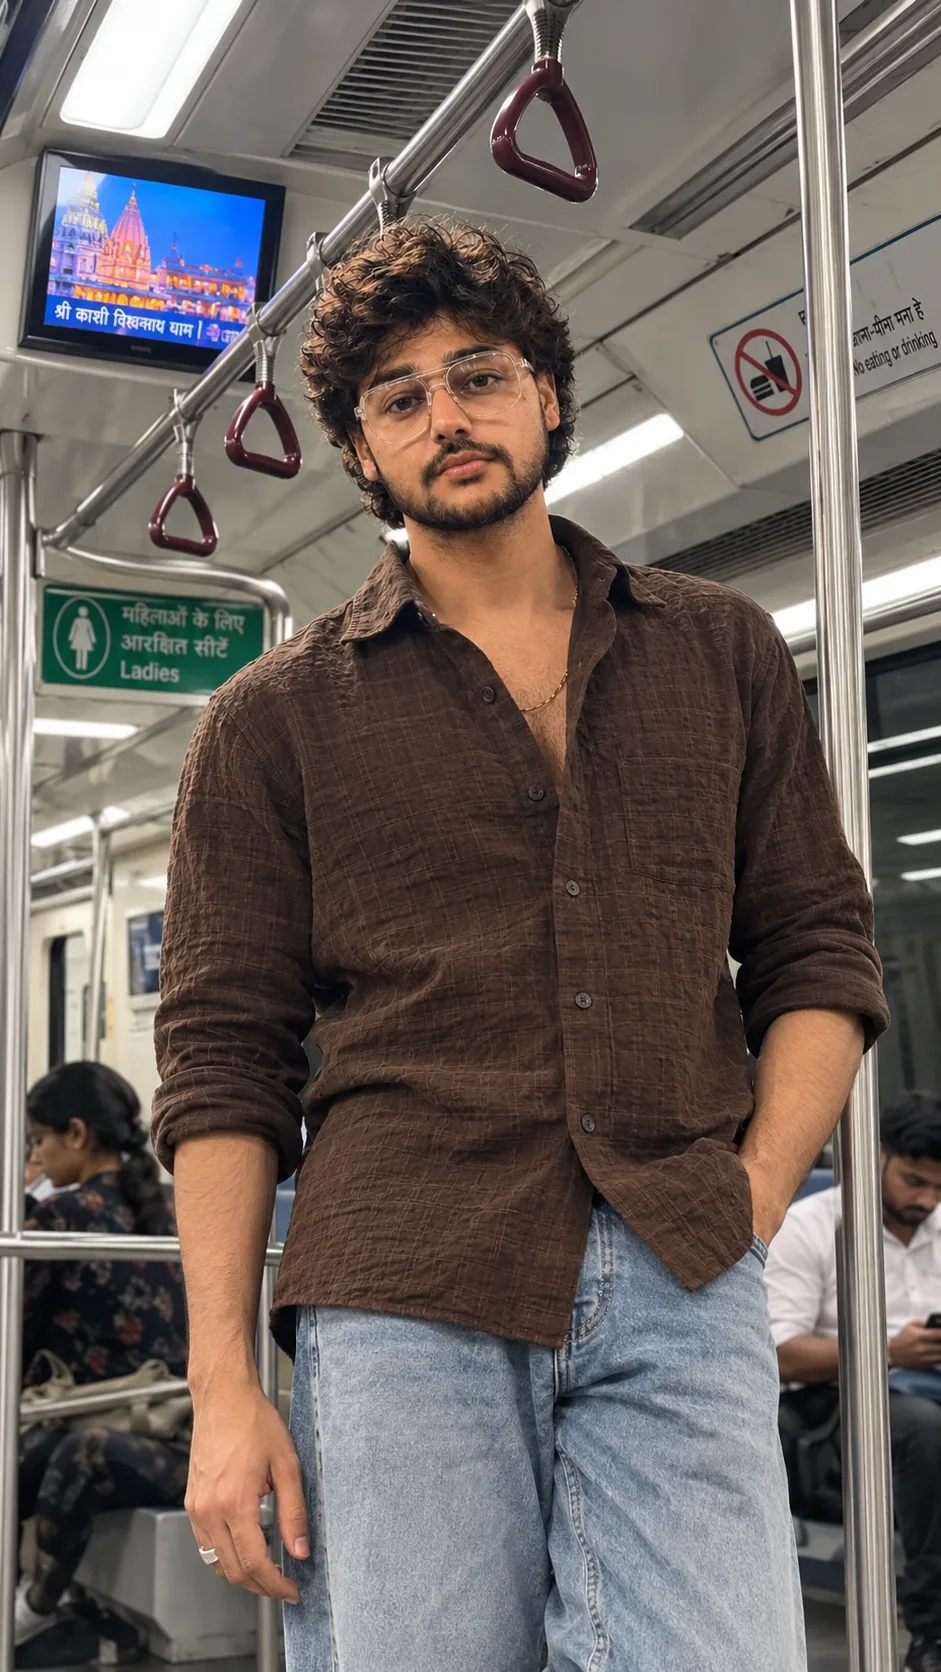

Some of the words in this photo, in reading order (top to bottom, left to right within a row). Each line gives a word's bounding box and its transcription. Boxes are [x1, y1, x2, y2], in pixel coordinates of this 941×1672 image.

[54, 300, 72, 320] श्री
[75, 306, 109, 325] काशी
[893, 307, 914, 326] मना
[864, 350, 893, 371] eating
[891, 345, 903, 360] or
[901, 331, 938, 355] drinking
[121, 602, 188, 628] महिलाओं
[192, 607, 210, 628] के
[214, 608, 246, 635] लिए
[120, 631, 189, 655] आरक्षित
[193, 635, 229, 659] सीटें
[120, 660, 180, 683] Ladies
